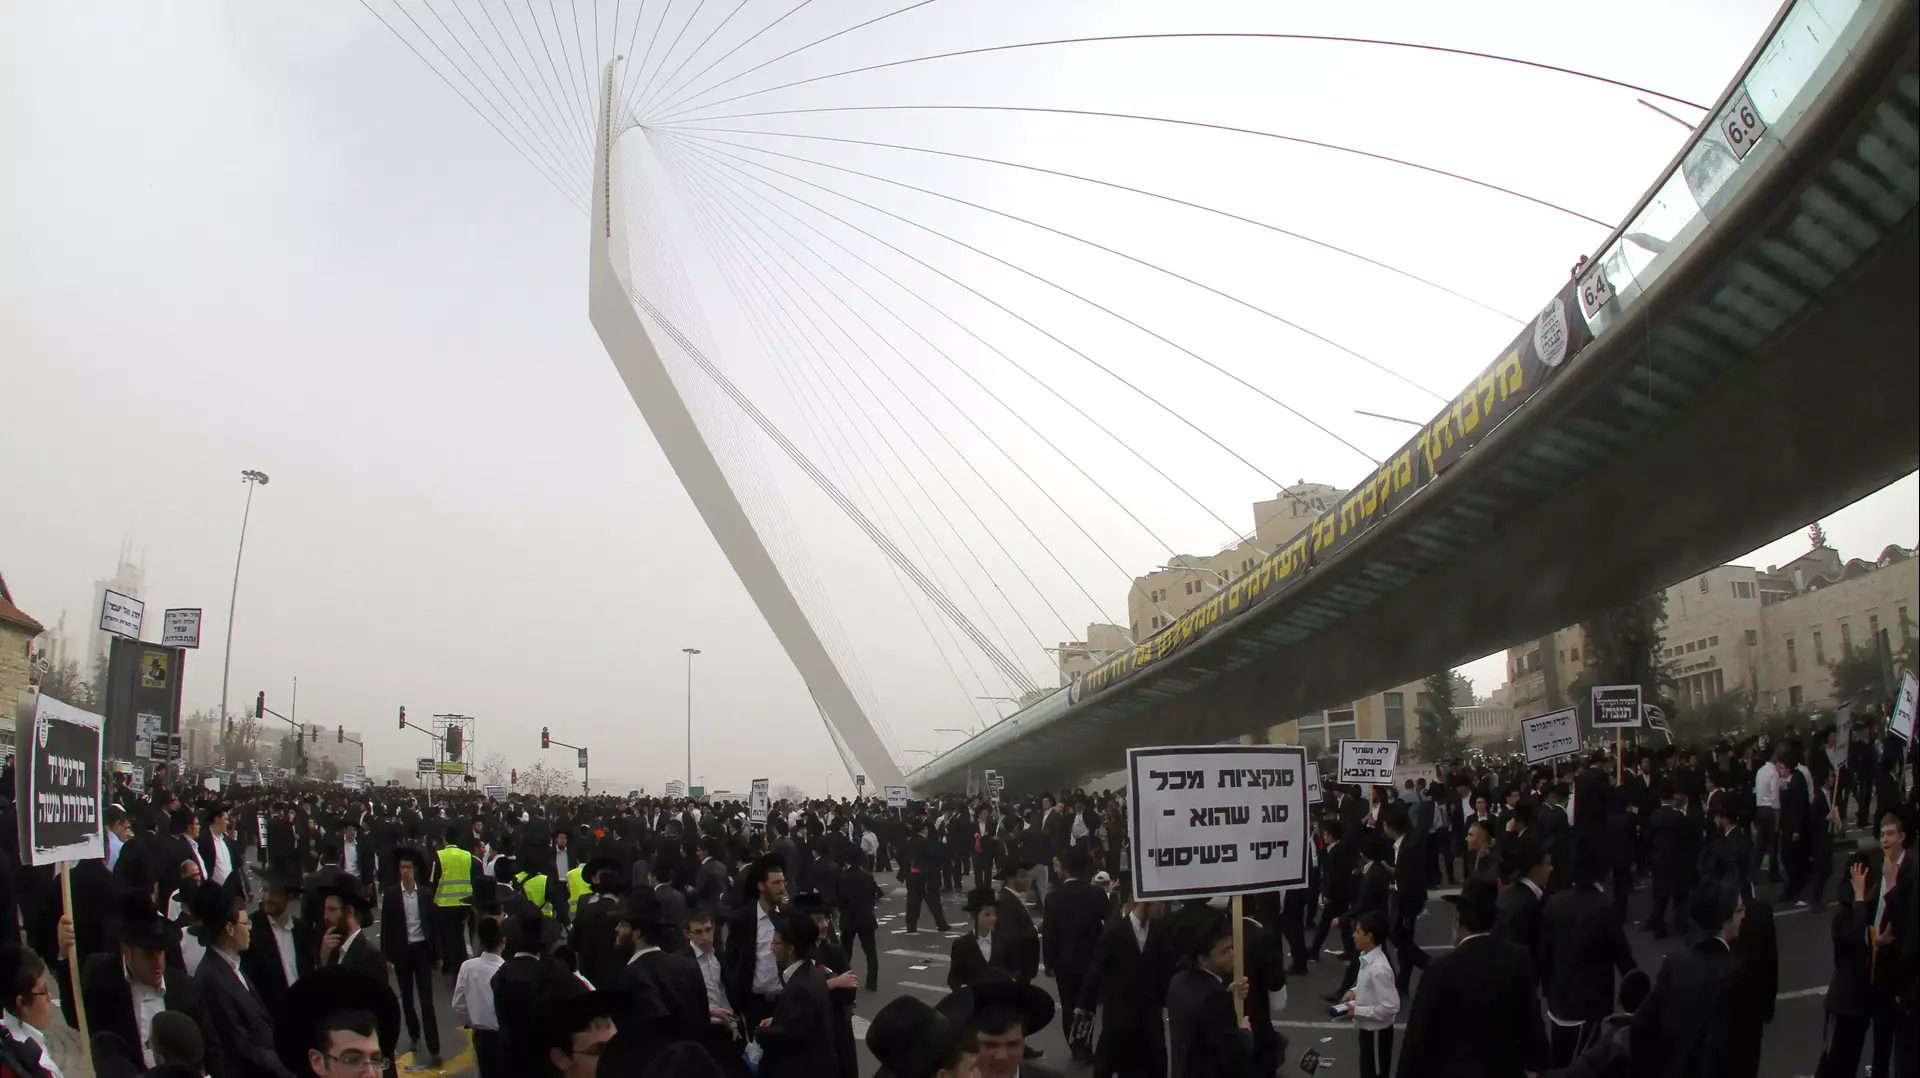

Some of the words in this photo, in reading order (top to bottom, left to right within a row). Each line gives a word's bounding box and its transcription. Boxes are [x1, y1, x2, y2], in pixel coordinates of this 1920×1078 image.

[1729, 106, 1755, 144] 6.6
[1584, 275, 1605, 306] 6.4
[1417, 348, 1523, 475] מלכותך
[1340, 450, 1411, 536] מלכות
[1311, 512, 1335, 554] כל
[1229, 535, 1307, 611] העולמים
[1087, 664, 1109, 691] ודור
[1111, 652, 1130, 678] דור
[1601, 706, 1632, 719] תנצח!
[1352, 747, 1373, 755] נשתף
[1150, 769, 1204, 791] מכל
[1217, 769, 1294, 790] סנקציות
[1344, 768, 1375, 777] הצבא
[1380, 769, 1392, 778] עם
[38, 791, 61, 823] משה
[62, 793, 96, 823] בתורת
[1189, 805, 1250, 828] שהוא
[1262, 804, 1289, 823] סוג
[1148, 844, 1238, 868] פשיסטי
[1250, 840, 1289, 861] דיכוי
